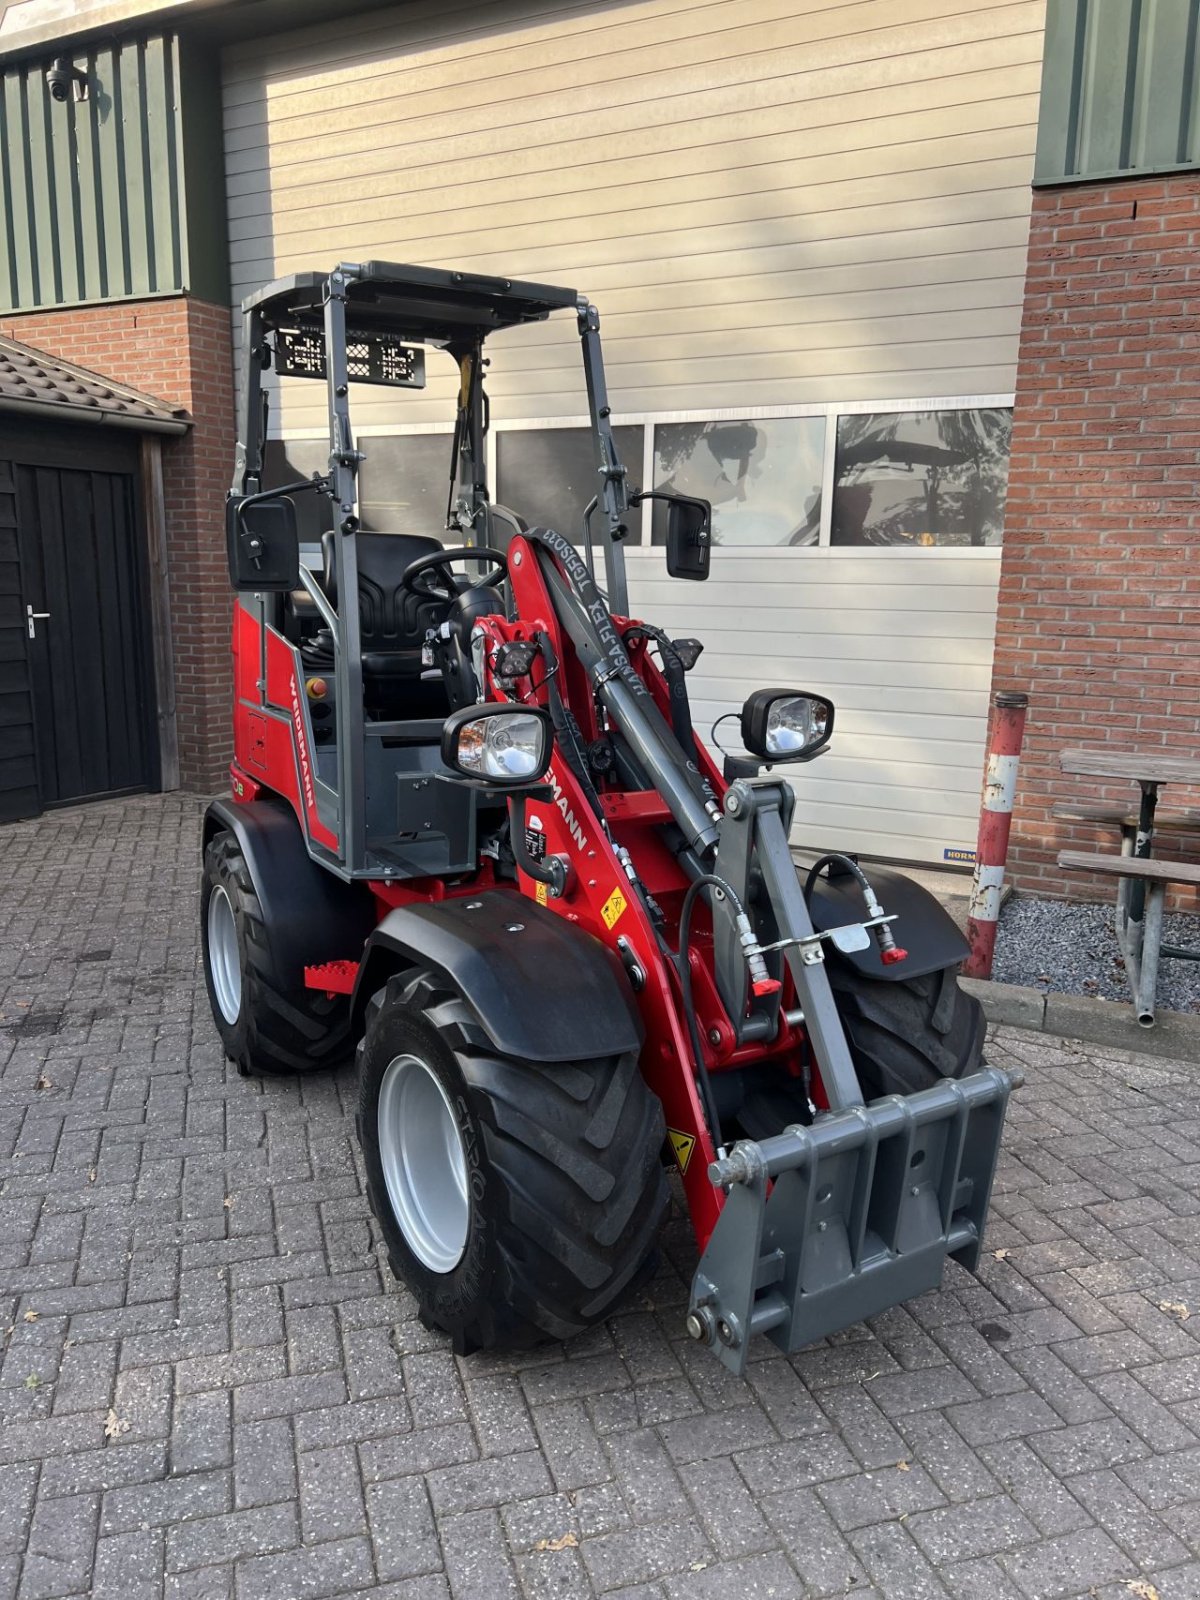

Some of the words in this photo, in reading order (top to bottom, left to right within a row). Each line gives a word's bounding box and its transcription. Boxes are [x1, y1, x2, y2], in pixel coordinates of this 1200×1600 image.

[588, 599, 648, 696] HANSA-FLEX
[289, 673, 314, 808] WEIDEMANN
[543, 765, 588, 852] EMANN
[456, 1095, 488, 1202] STARCO
